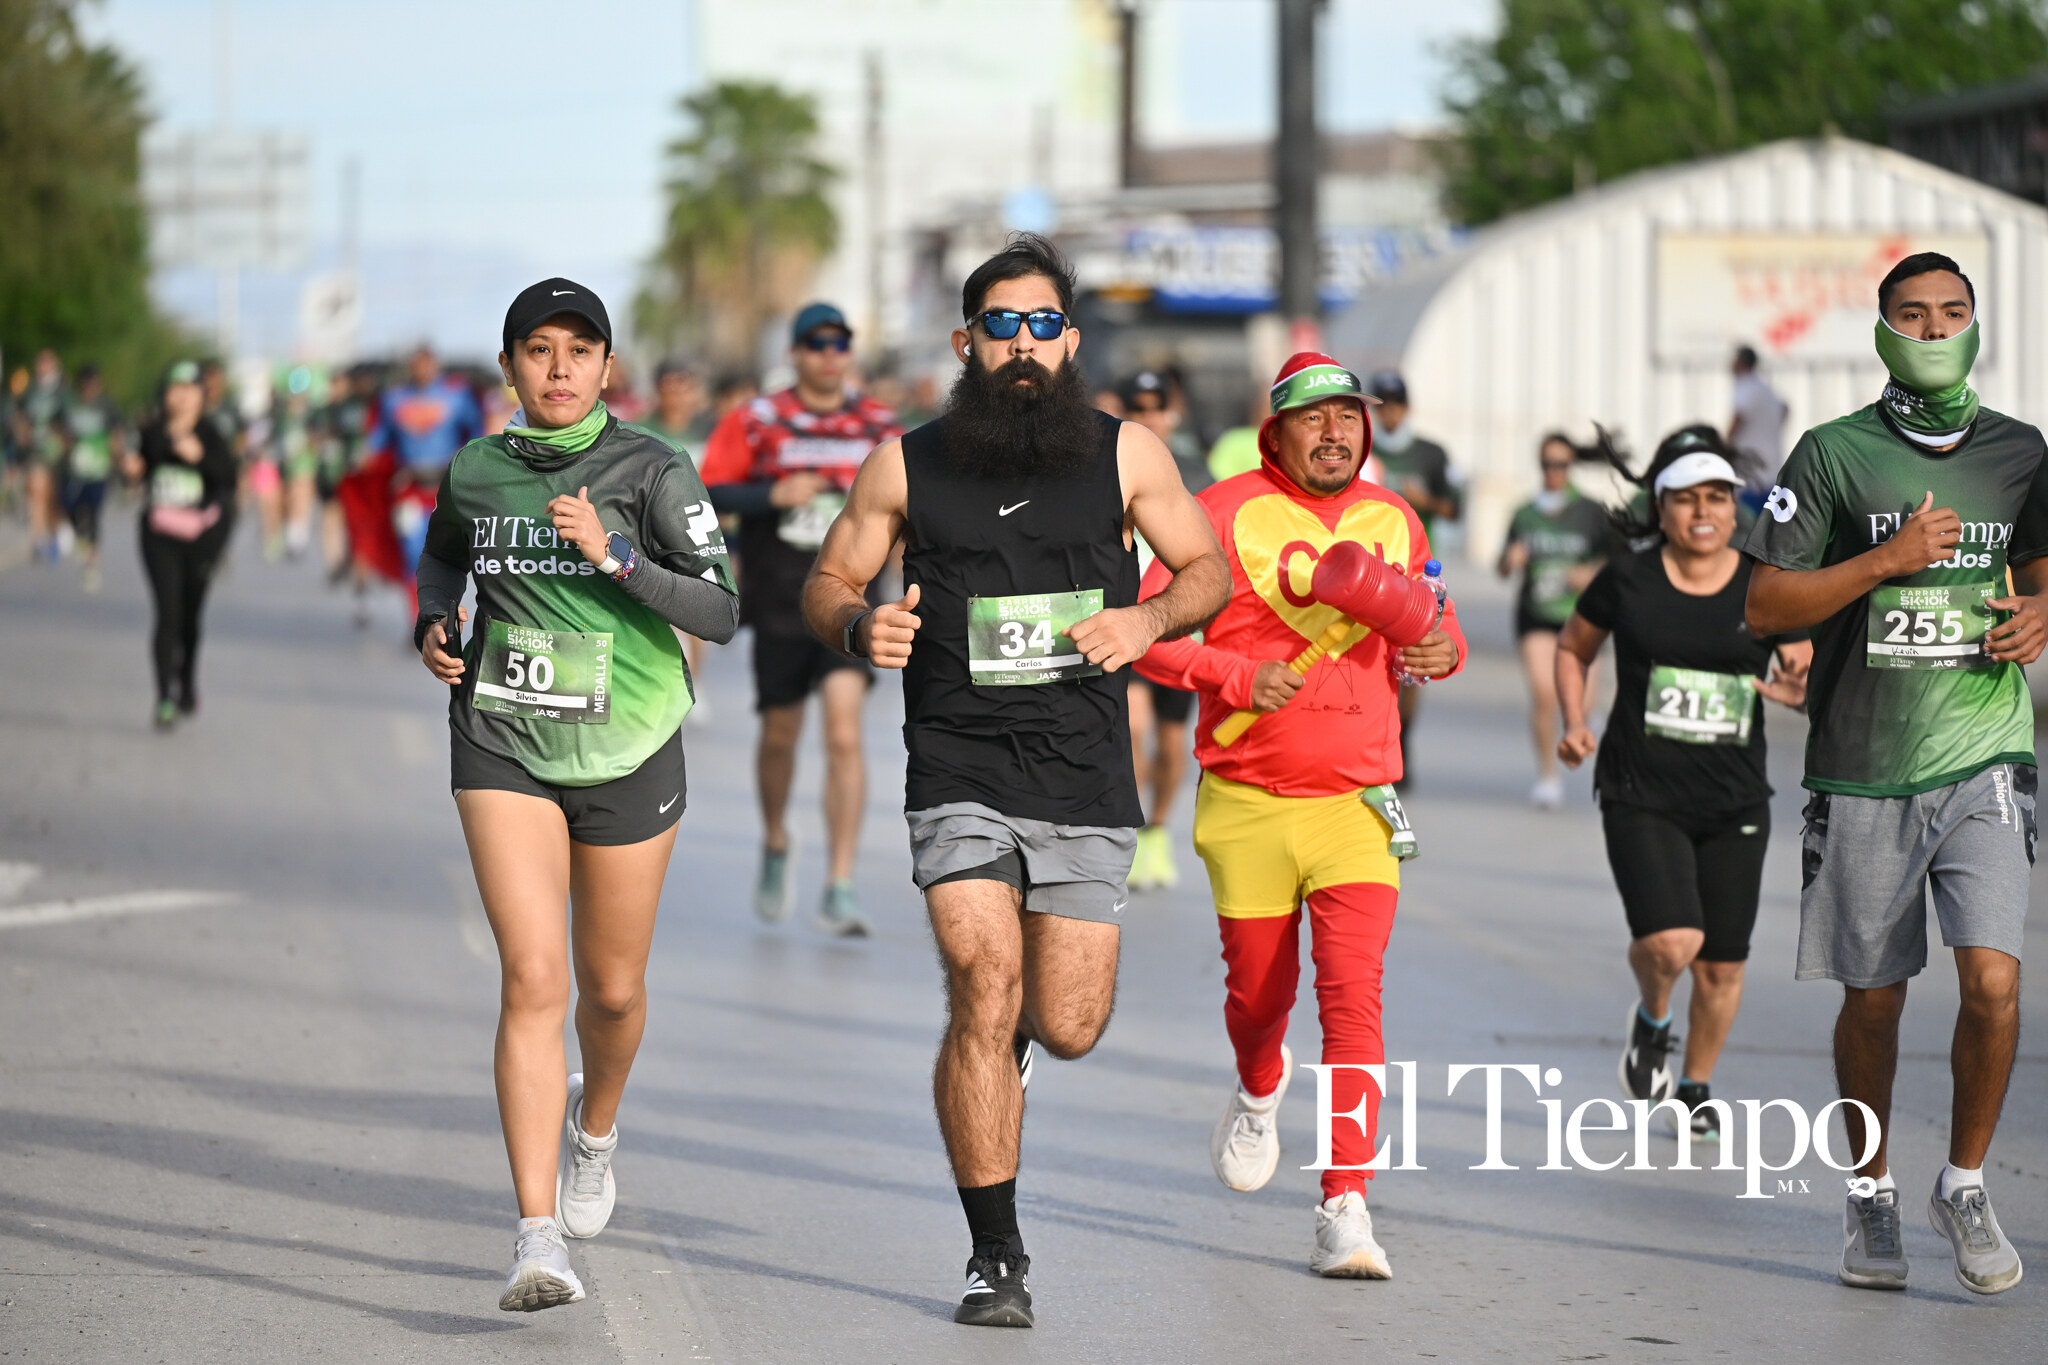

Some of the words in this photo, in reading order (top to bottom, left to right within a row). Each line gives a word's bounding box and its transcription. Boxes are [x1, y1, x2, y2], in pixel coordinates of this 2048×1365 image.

[473, 516, 498, 548] El
[474, 555, 501, 574] de
[505, 555, 596, 576] todos
[998, 596, 1051, 606] CARRERA
[1089, 596, 1099, 604] 34
[1981, 589, 1993, 597] 255
[507, 627, 554, 641] CARRERA
[1884, 610, 1964, 645] 255
[596, 640, 607, 648] 50
[999, 620, 1055, 657] 34
[505, 651, 555, 692] 50
[1015, 660, 1042, 668] Carlos
[594, 654, 607, 713] MEDALLA
[516, 692, 538, 702] Silvia
[1660, 686, 1726, 721] 215
